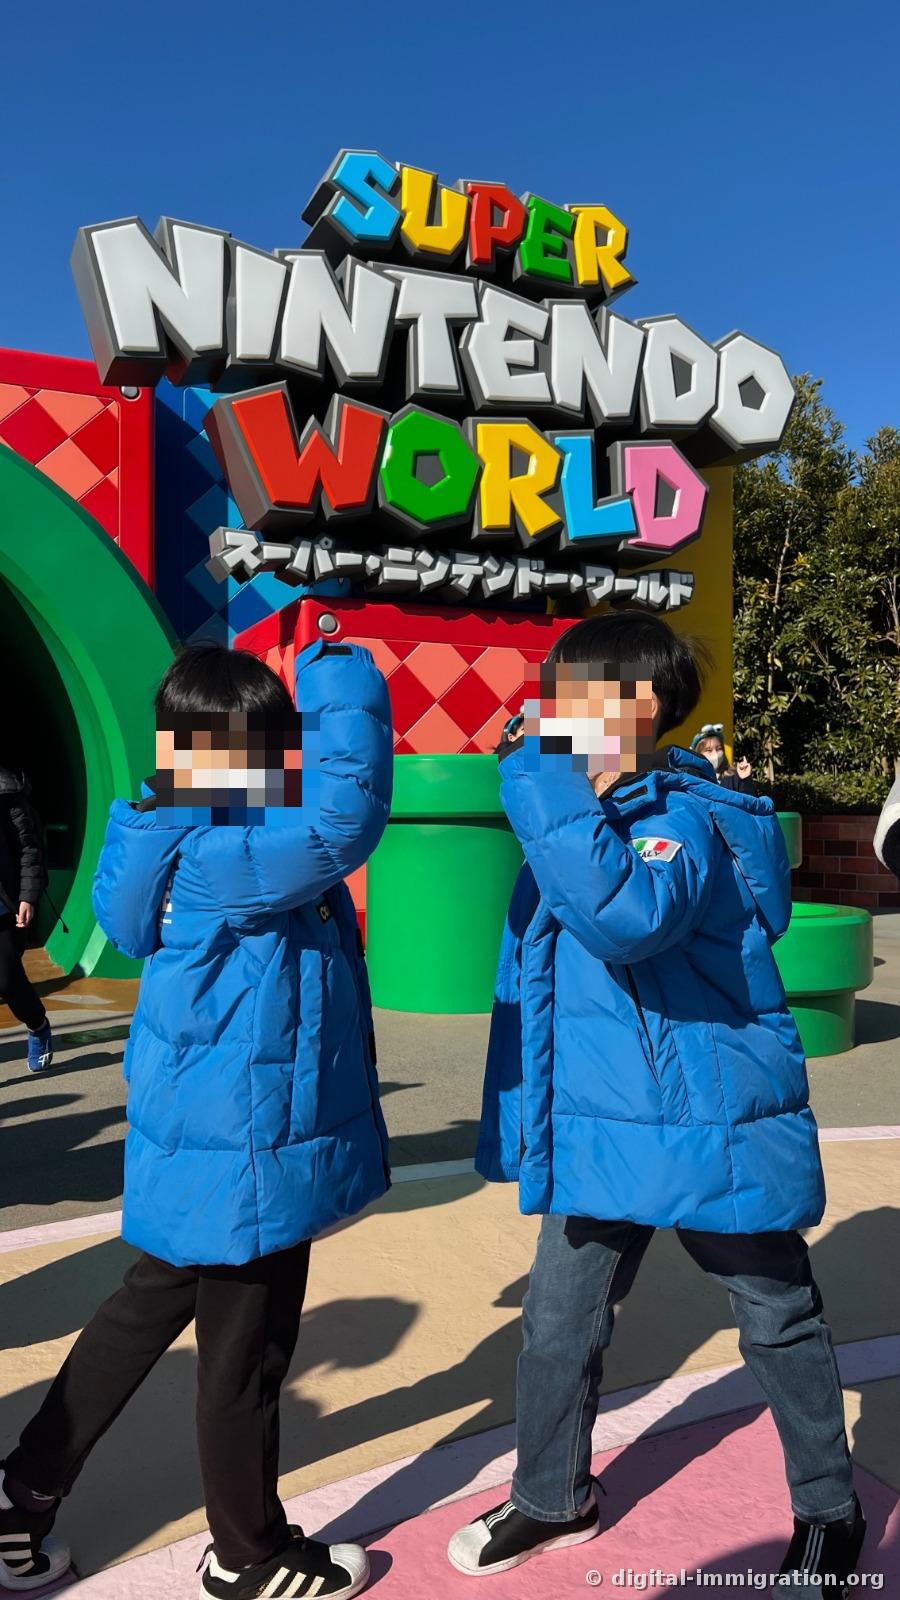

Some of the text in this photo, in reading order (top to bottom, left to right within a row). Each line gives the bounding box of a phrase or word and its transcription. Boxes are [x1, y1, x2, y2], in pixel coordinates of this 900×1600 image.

[331, 150, 633, 293] SUPER
[91, 221, 796, 445] NINTENDO
[231, 388, 707, 547] WORLD
